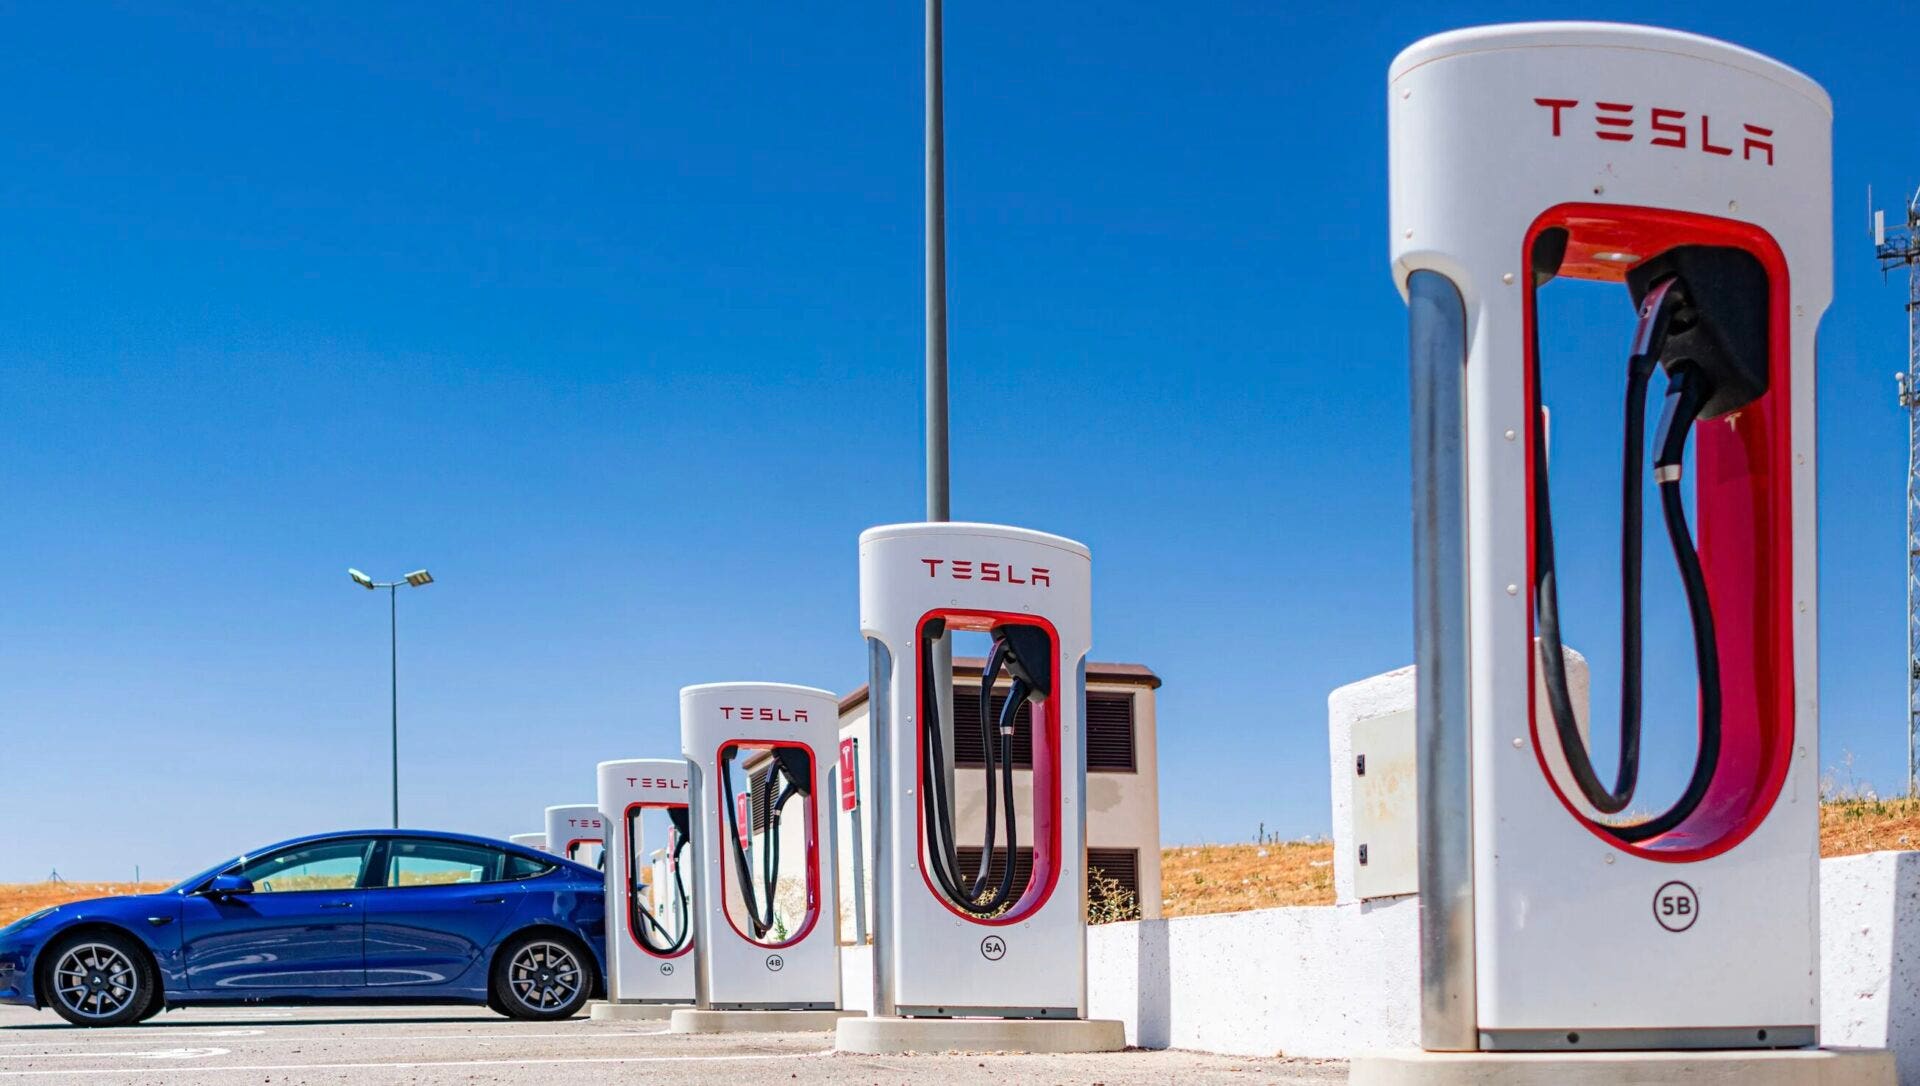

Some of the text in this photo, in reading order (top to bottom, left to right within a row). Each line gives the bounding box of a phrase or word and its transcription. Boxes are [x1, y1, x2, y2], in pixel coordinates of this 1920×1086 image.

[1534, 98, 1774, 166] TESLA
[921, 558, 1051, 588] TESLA
[720, 707, 808, 722] TESLA
[568, 819, 600, 828] TES
[1662, 897, 1691, 915] 5B
[985, 943, 1002, 953] 5A
[769, 959, 782, 967] 4B
